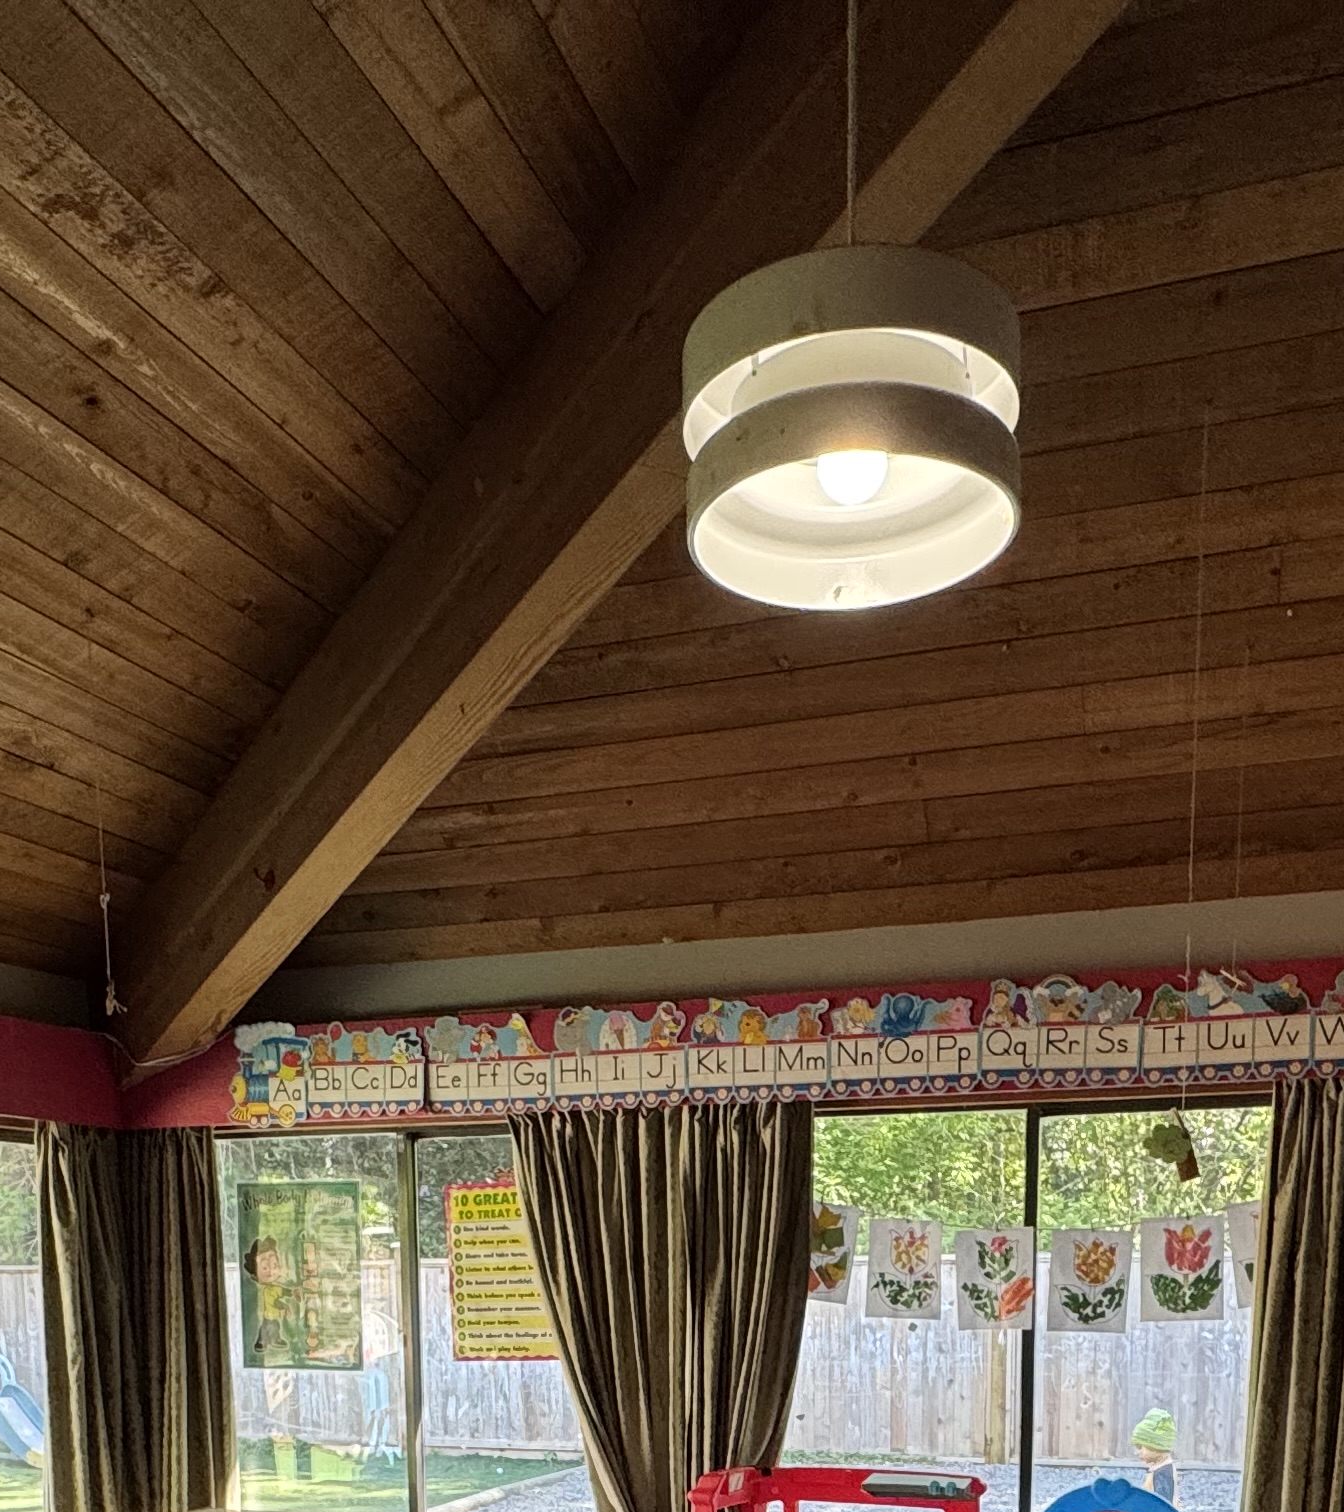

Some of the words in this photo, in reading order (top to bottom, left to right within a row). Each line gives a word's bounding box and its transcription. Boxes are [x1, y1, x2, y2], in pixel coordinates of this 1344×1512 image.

[274, 1082, 301, 1101] Aa
[314, 1068, 342, 1090] Bb
[351, 1067, 379, 1090] Cc
[390, 1065, 417, 1088] Dd
[436, 1066, 461, 1088] Ee
[477, 1063, 500, 1087] Ff
[514, 1062, 547, 1096] Gg
[560, 1059, 591, 1083] Hh
[613, 1056, 625, 1080] Ii
[646, 1054, 677, 1088] Jj
[697, 1050, 726, 1074] Kk
[778, 1045, 825, 1071] Mm
[838, 1040, 872, 1066] Nn
[884, 1038, 923, 1063] Oo
[937, 1036, 971, 1073] Pp
[986, 1029, 1032, 1068] Qq
[1046, 1028, 1079, 1055] Rr
[1095, 1027, 1127, 1053] Ss
[1154, 1025, 1186, 1053] Tt
[1207, 1023, 1246, 1050] Uu
[1265, 1019, 1300, 1046] Vv
[454, 1194, 469, 1207] 10
[473, 1192, 517, 1206] GREAT
[458, 1210, 474, 1220] TO
[477, 1208, 511, 1219] TREAT
